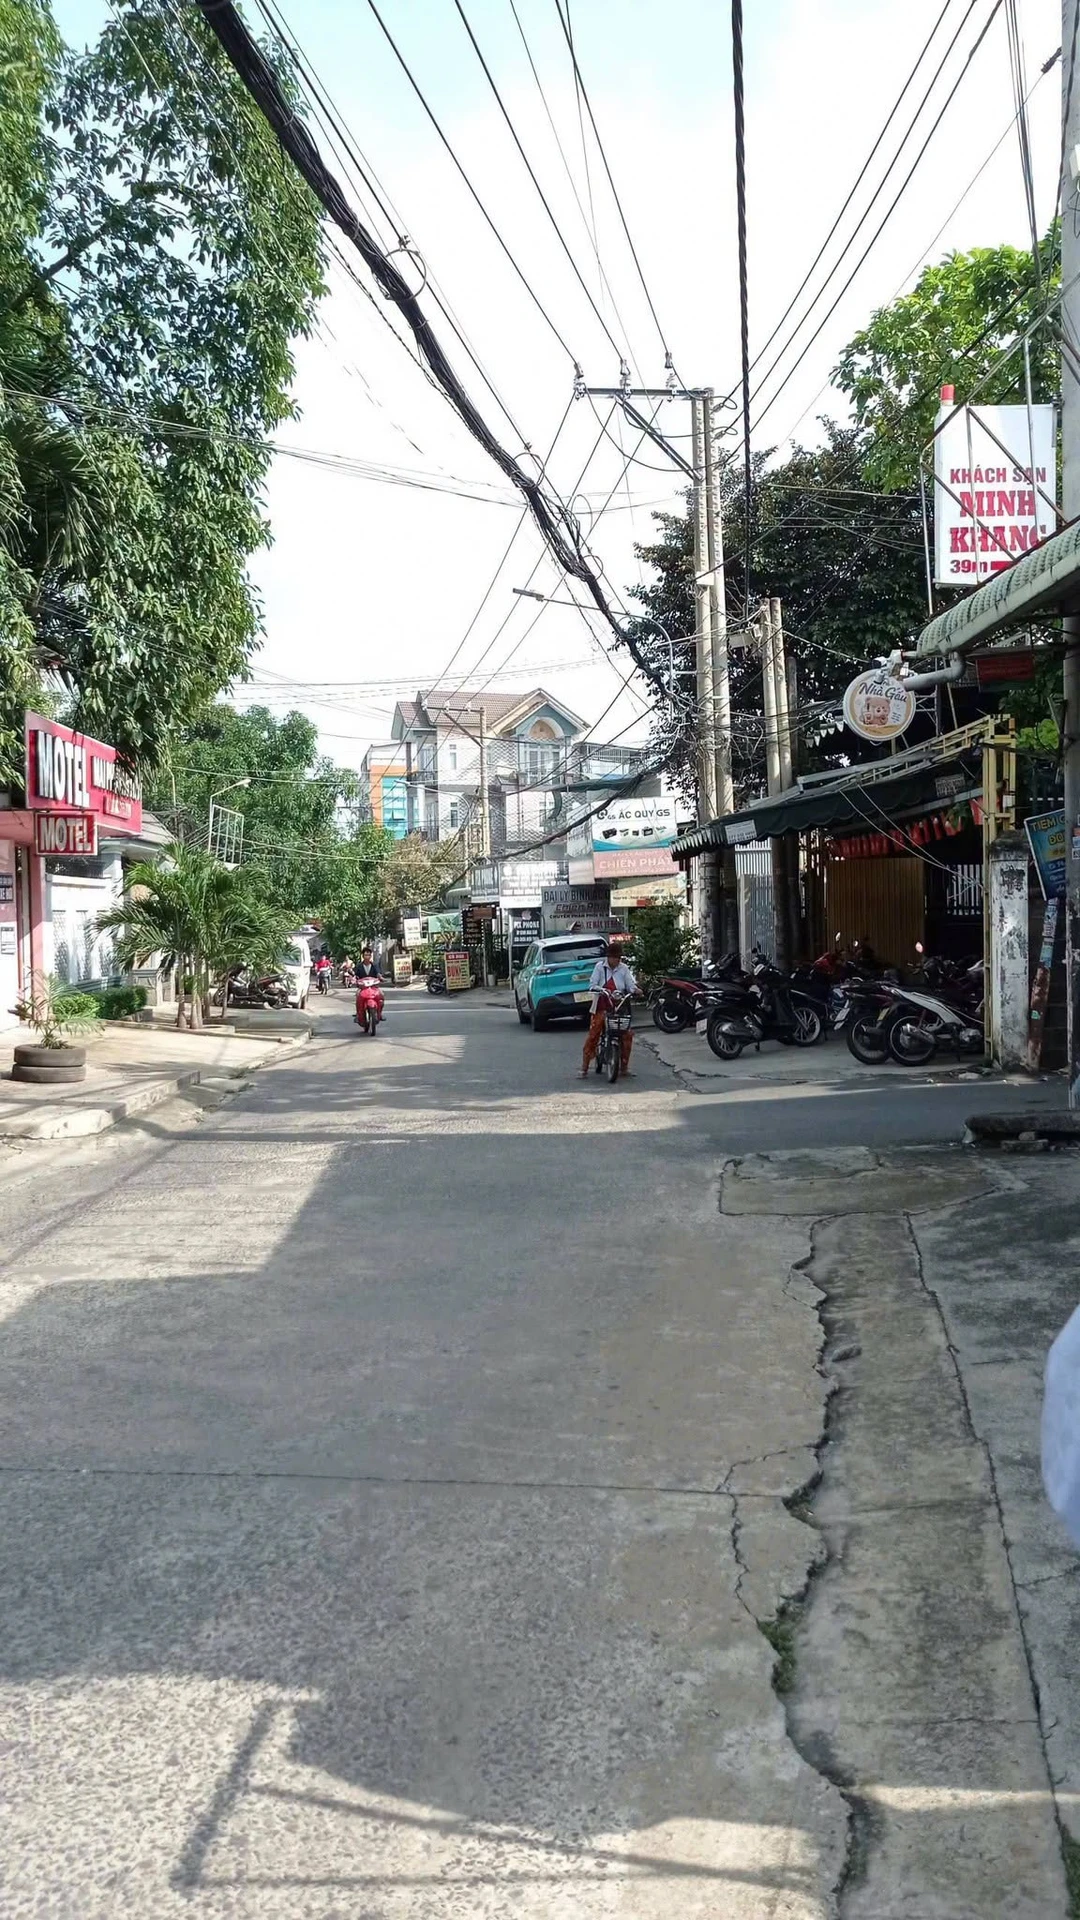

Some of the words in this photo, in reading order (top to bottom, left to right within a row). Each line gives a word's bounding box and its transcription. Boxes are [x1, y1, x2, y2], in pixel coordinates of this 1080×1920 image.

[950, 464, 1007, 484] KHÁCH
[1012, 467, 1047, 486] SẠN
[959, 490, 1037, 518] MINH
[37, 729, 91, 809] MOTEL
[655, 808, 671, 817] GS
[40, 816, 92, 853] MOTEL
